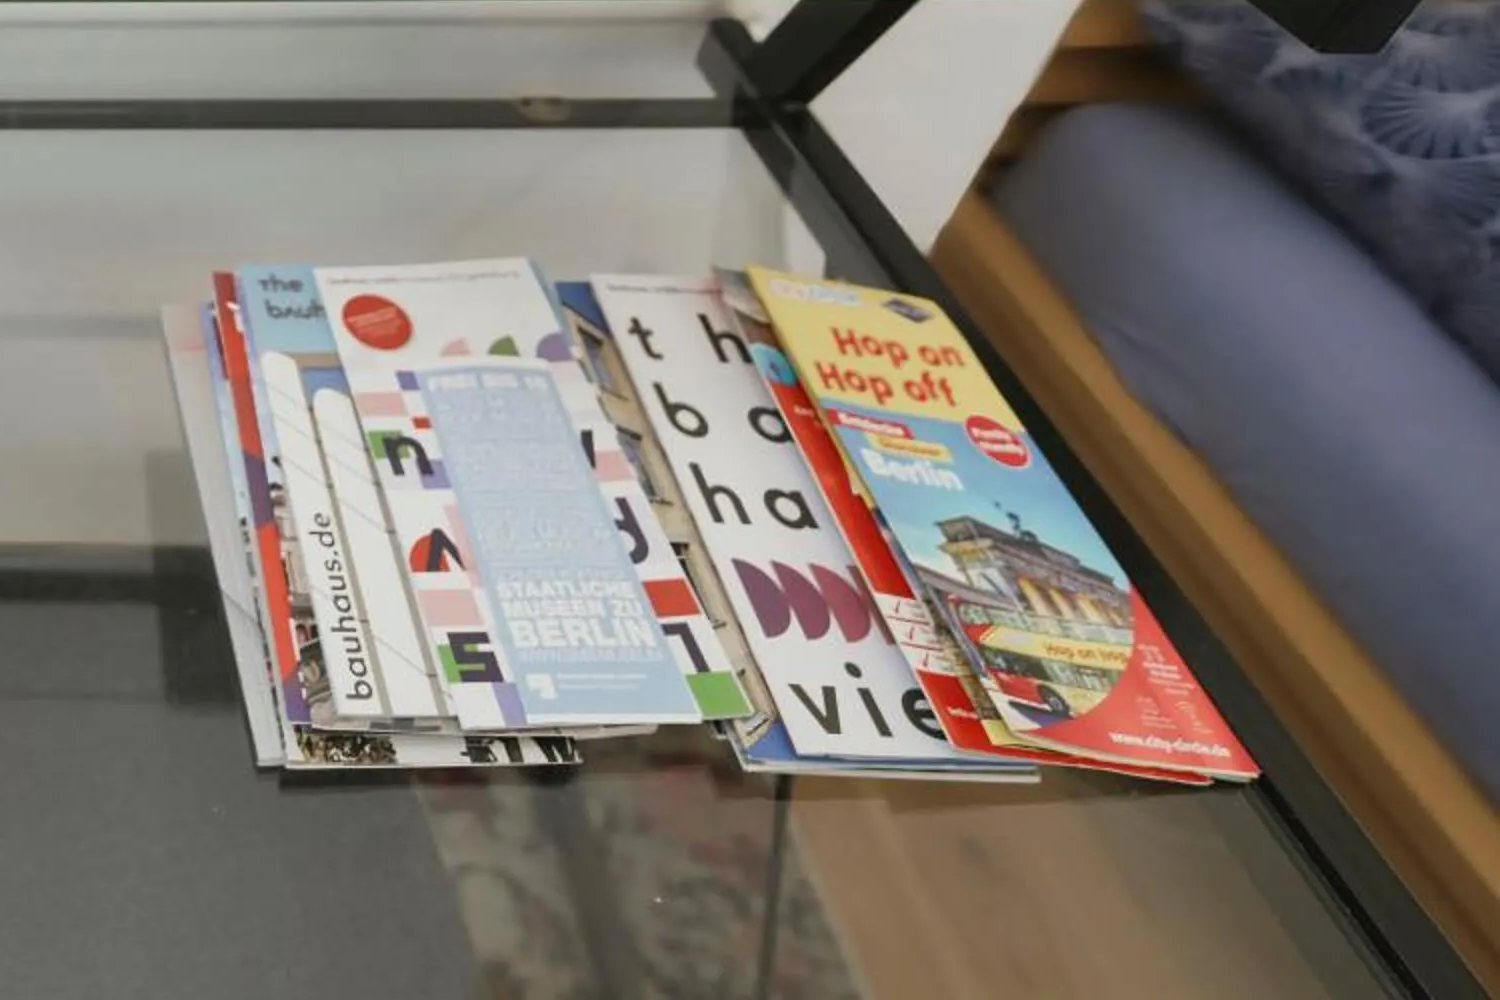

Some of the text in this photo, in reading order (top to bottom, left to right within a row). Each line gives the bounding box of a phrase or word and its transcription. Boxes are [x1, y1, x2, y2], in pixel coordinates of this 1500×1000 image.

[831, 325, 966, 369] Hop on
[814, 359, 956, 407] Hop off
[860, 447, 965, 491] Berlin
[308, 512, 373, 700] bauhaus.de
[497, 580, 638, 598] STAATLICHE
[613, 599, 645, 617] ZU
[508, 618, 657, 648] BERLIN
